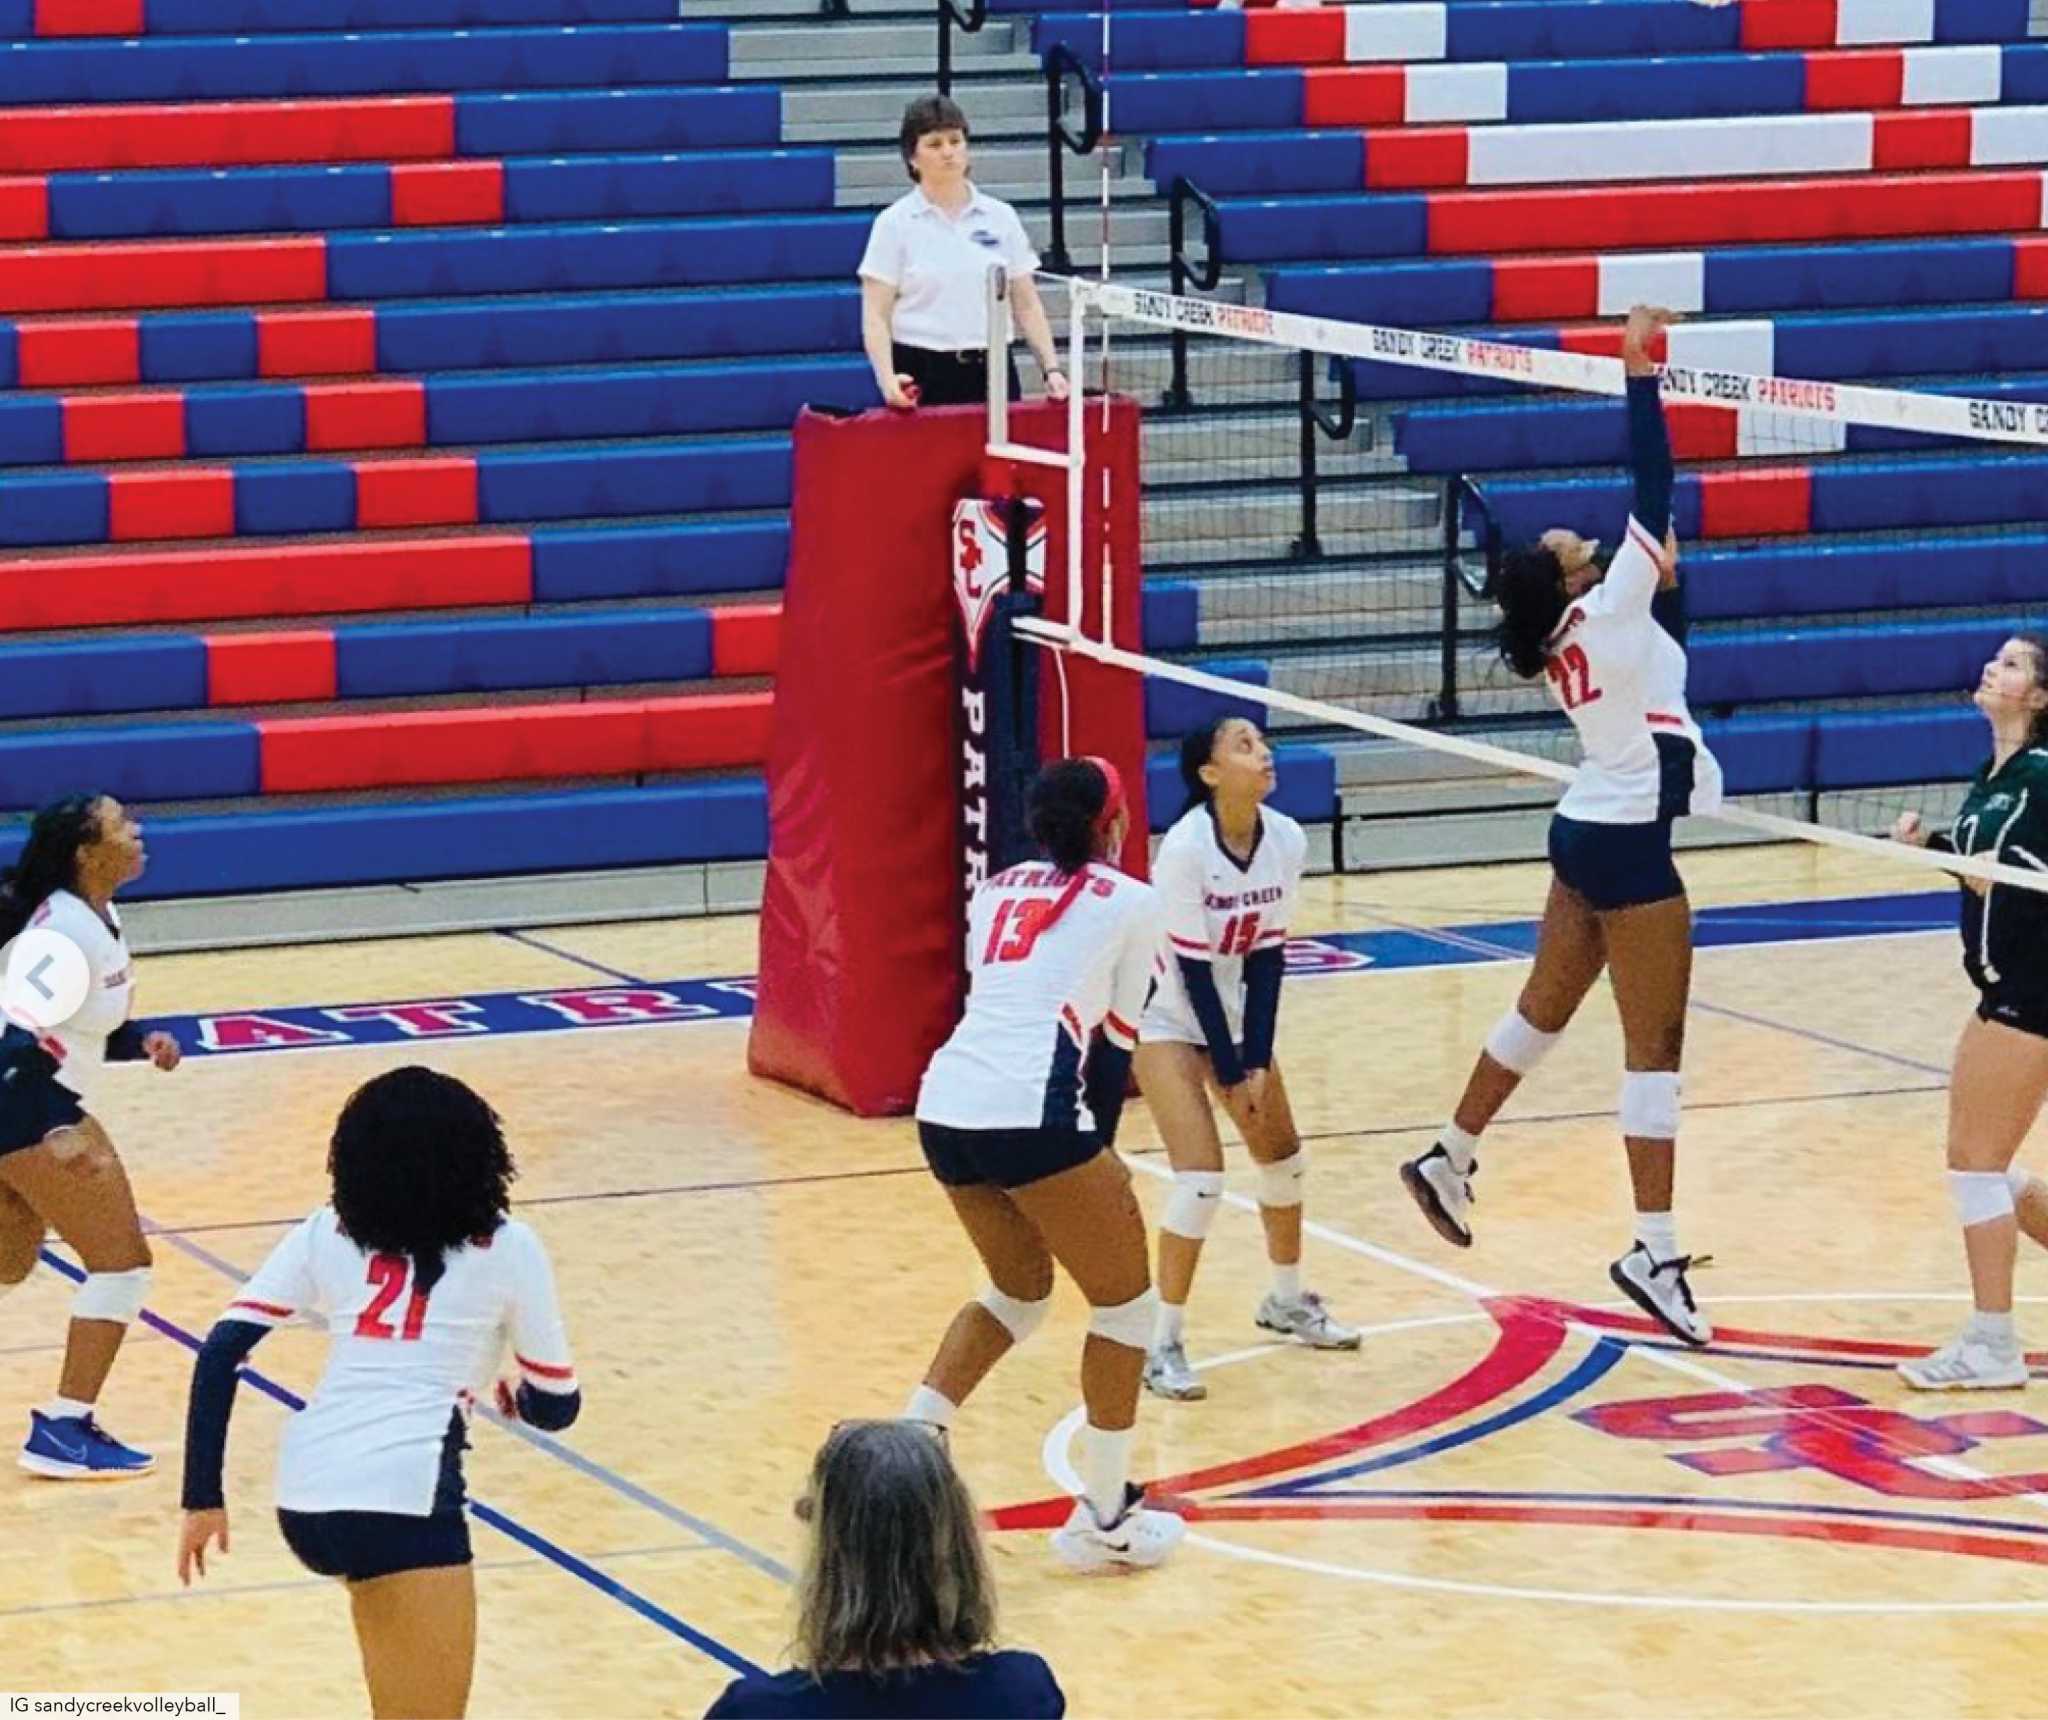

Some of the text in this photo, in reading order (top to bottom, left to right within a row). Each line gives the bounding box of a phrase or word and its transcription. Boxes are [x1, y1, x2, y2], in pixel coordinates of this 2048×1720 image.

[1373, 327, 1533, 374] SANDY CREEK PATRIOTS
[1658, 366, 1836, 411] ANDY CREEK PATRIOTS
[1969, 402, 2026, 432] SANDY
[962, 686, 988, 975] PATR
[983, 897, 1054, 964] 13
[1218, 912, 1260, 955] 15
[353, 1254, 429, 1341] 21
